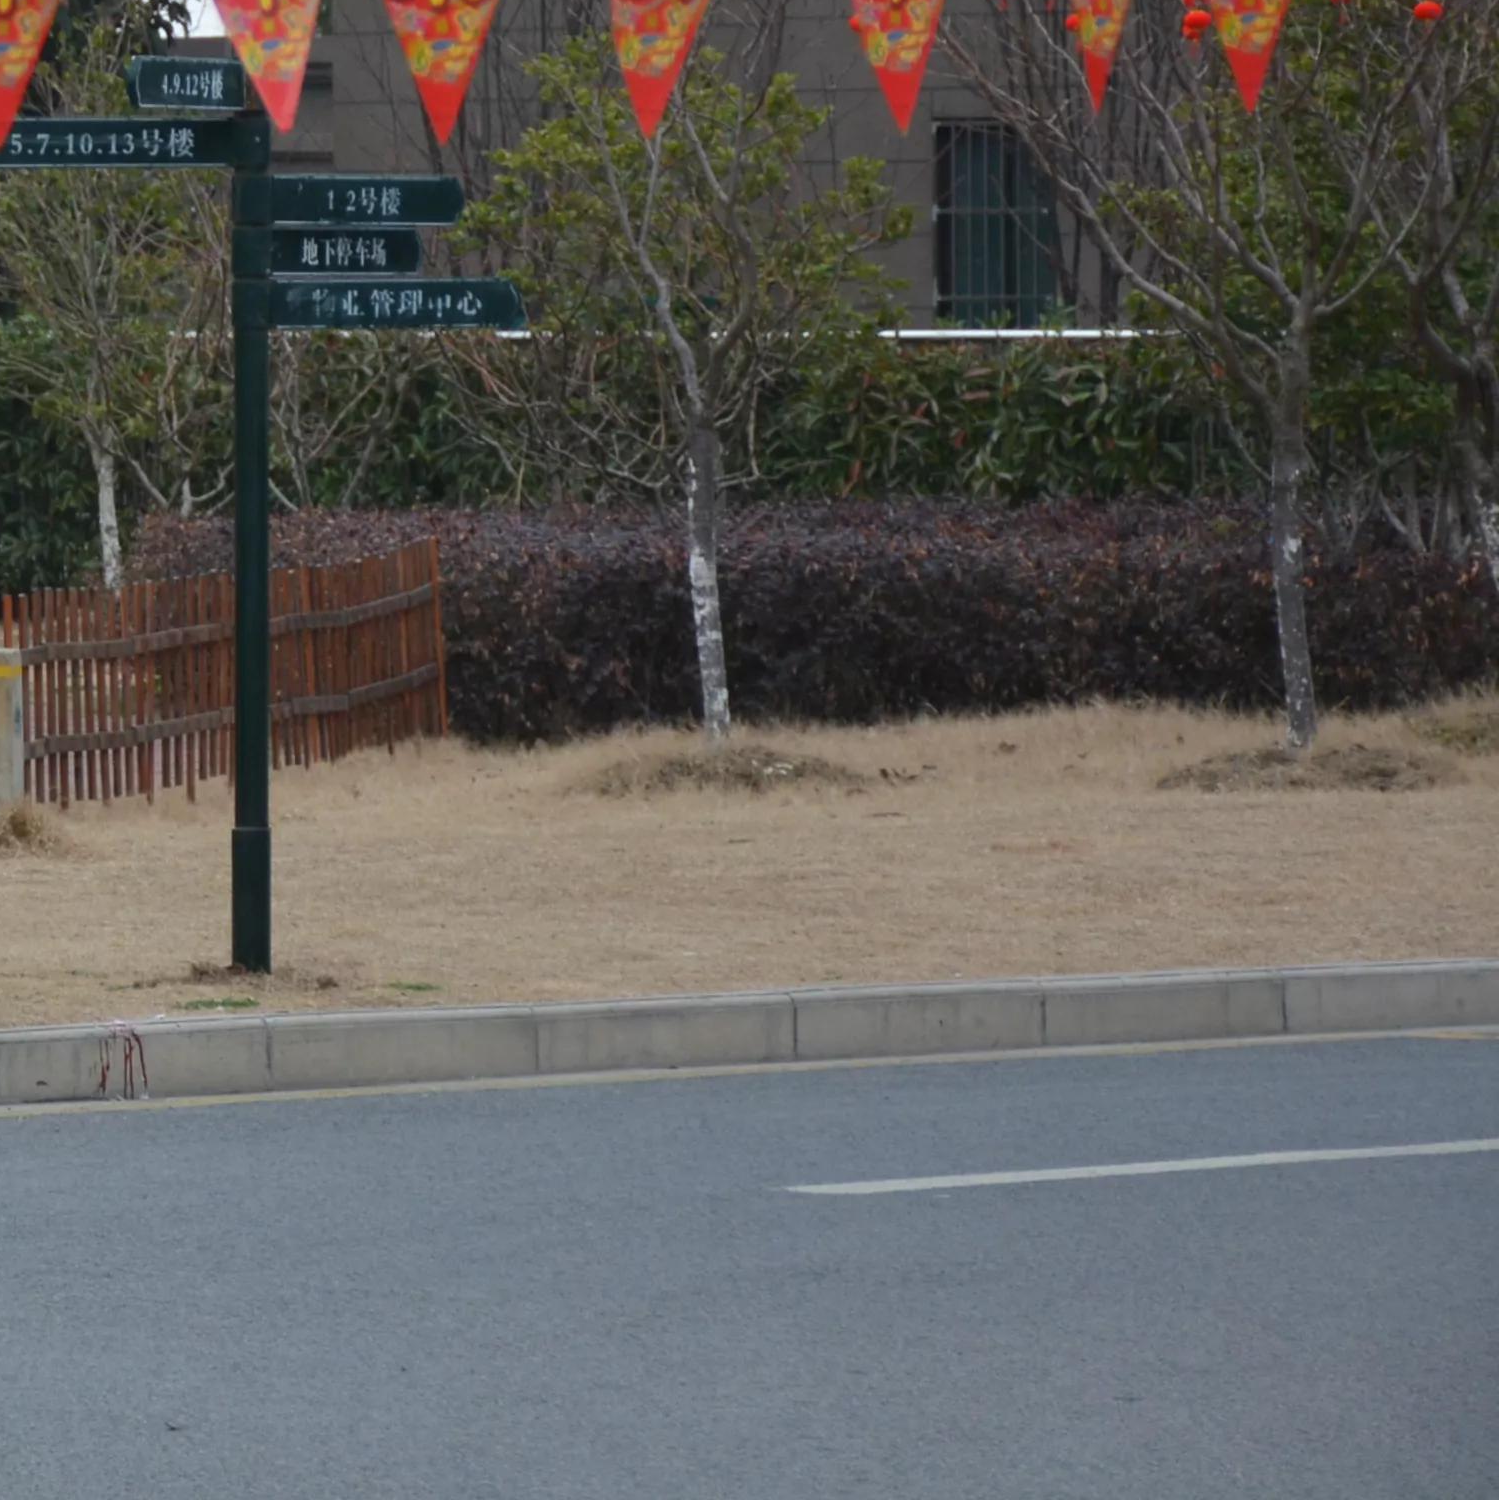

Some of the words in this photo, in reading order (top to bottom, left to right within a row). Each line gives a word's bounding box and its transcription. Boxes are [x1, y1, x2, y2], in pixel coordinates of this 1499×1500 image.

[10, 127, 196, 158] 5.7.10.13号楼
[302, 237, 387, 267] 地下停车场
